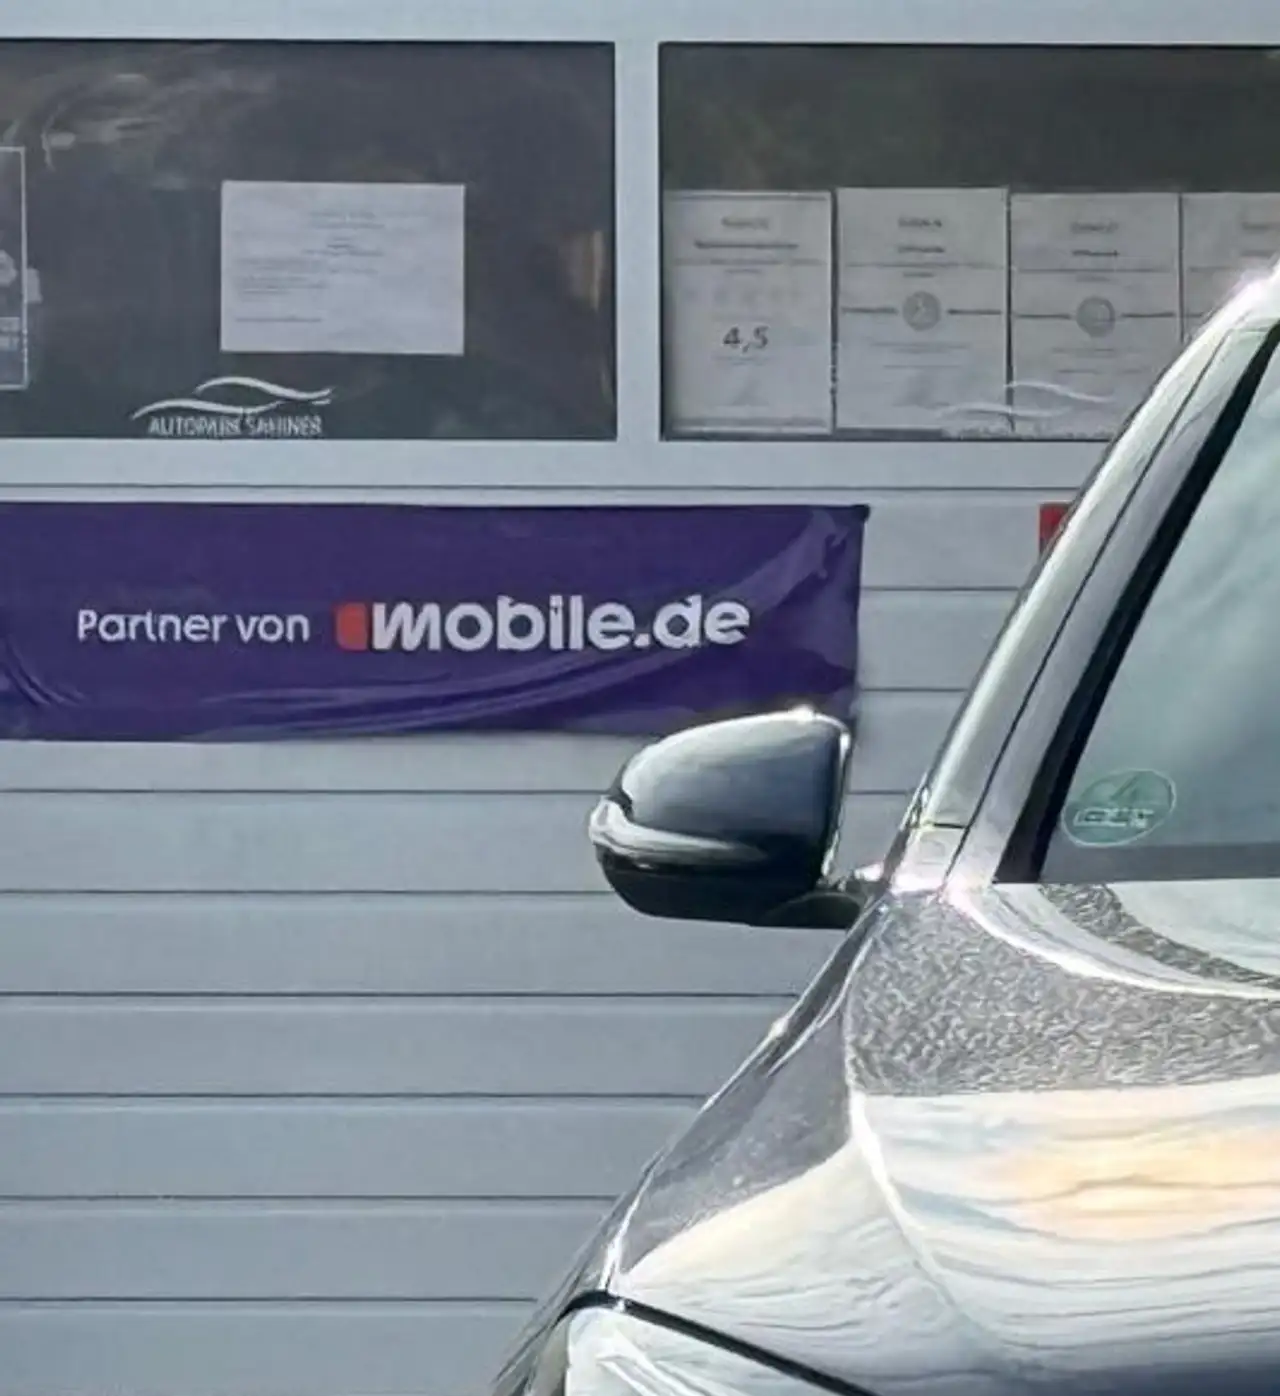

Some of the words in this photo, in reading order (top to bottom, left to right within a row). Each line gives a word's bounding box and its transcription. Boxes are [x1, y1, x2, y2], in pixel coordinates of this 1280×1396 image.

[721, 325, 769, 354] 4,5
[77, 608, 226, 643] Partner
[234, 613, 310, 643] von
[371, 594, 750, 651] mobile.de
